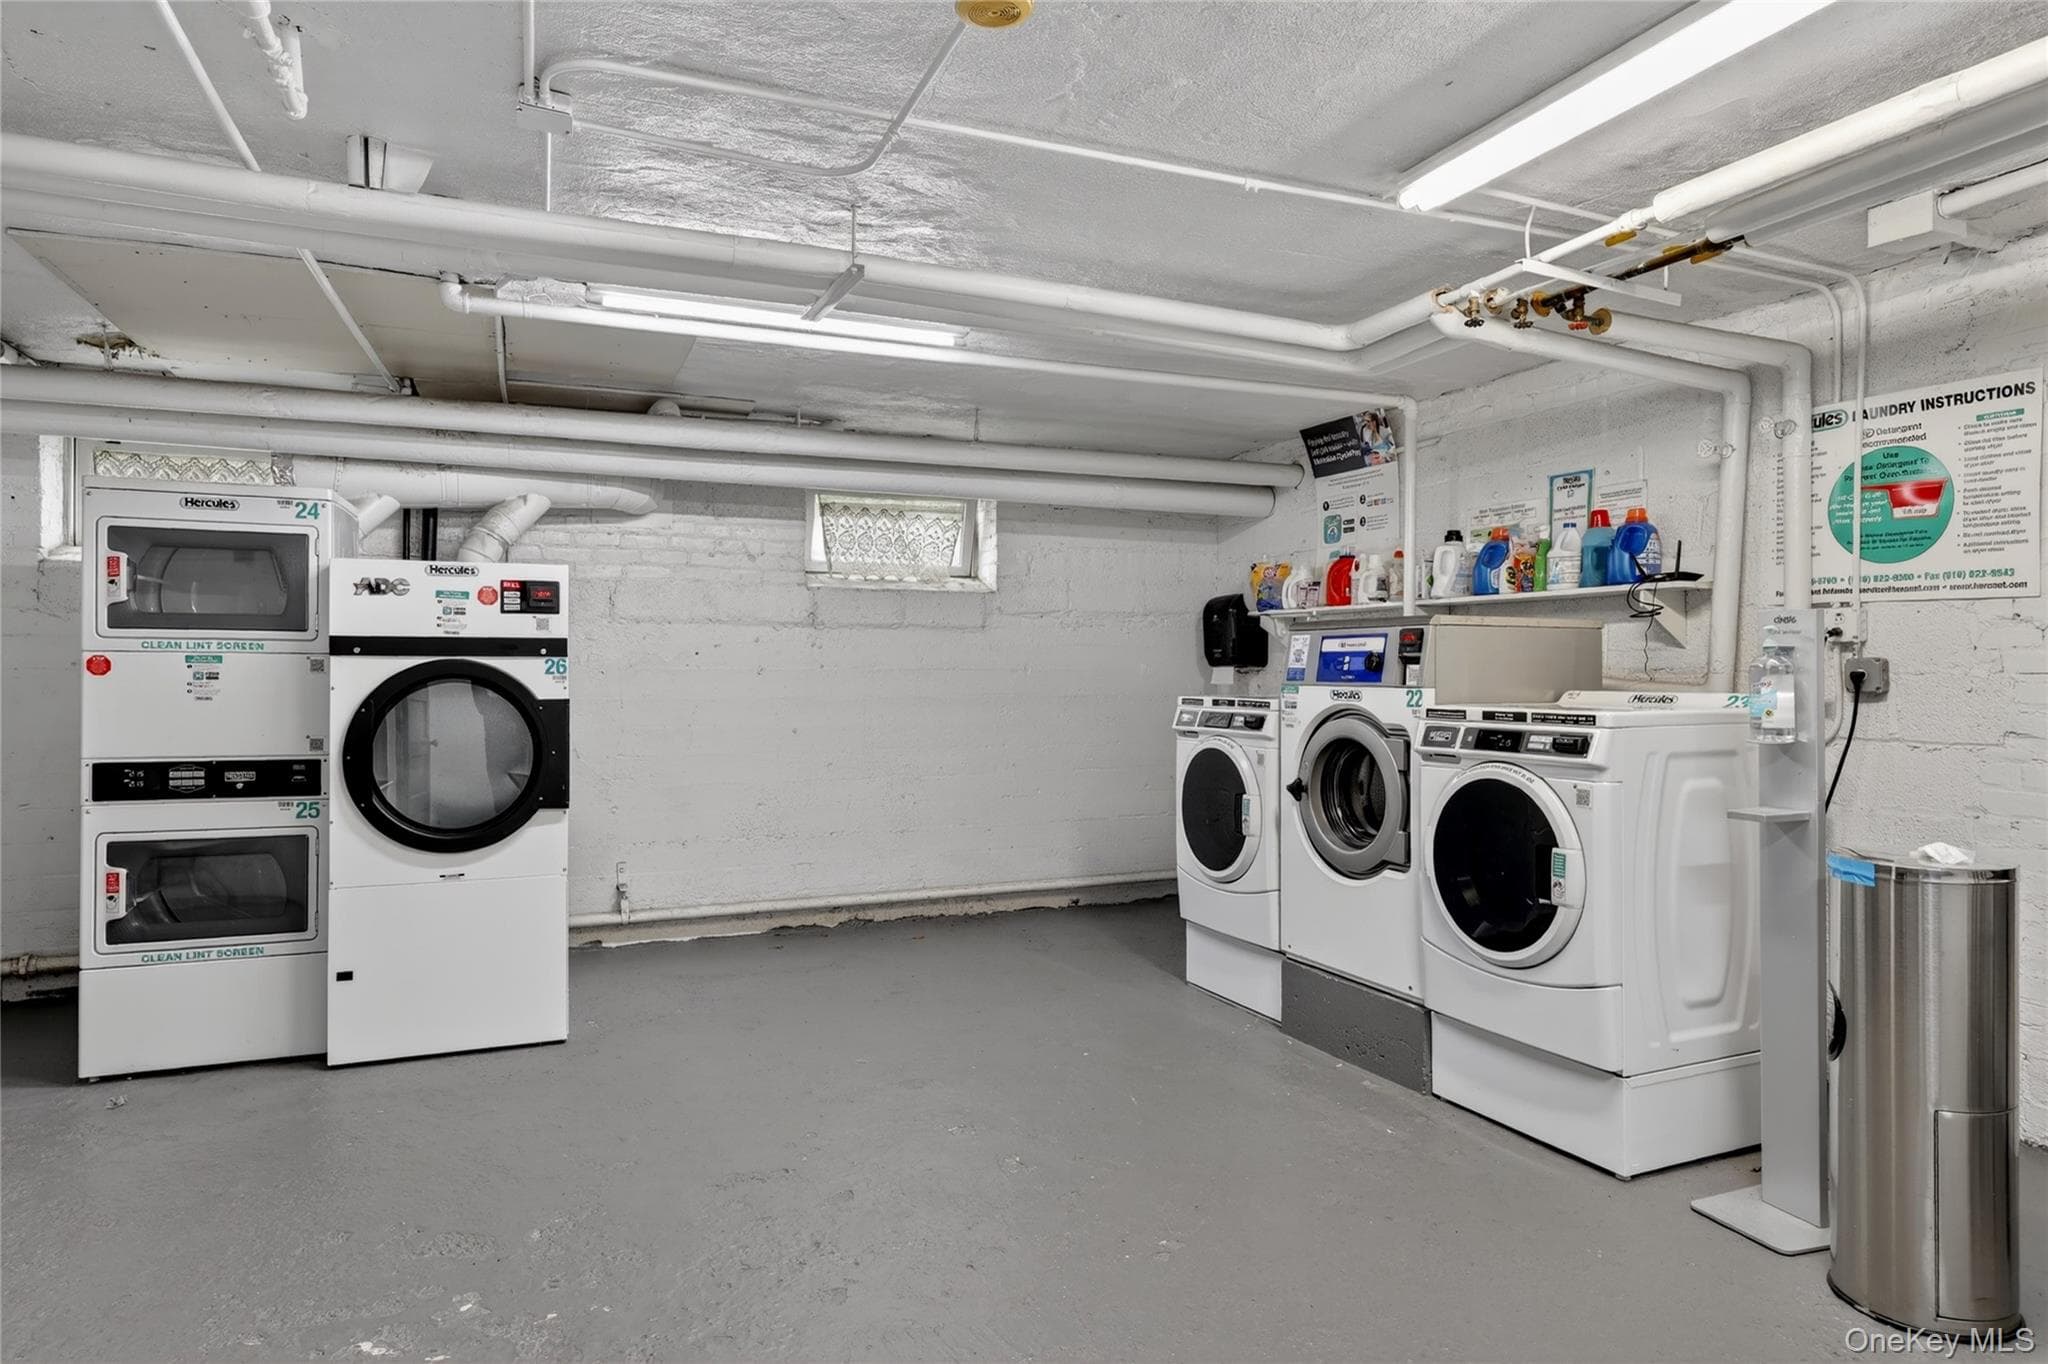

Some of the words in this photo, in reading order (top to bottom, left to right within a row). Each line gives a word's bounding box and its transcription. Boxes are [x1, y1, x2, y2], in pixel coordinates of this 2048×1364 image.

[1920, 381, 2036, 411] INSTRUCTIONS
[1812, 412, 1844, 429] ules
[184, 497, 236, 510] Hercules
[295, 501, 321, 520] 24
[429, 564, 476, 576] Hercules
[354, 577, 410, 596] ADC
[141, 640, 182, 650] CLEAN
[186, 641, 213, 650] LINT
[216, 642, 265, 651] SCREEN
[544, 658, 567, 675] 26
[1406, 690, 1423, 707] 22
[295, 801, 320, 819] 25
[141, 952, 182, 964] CLEAN
[186, 950, 213, 961] LINT
[216, 946, 265, 958] SCREEN
